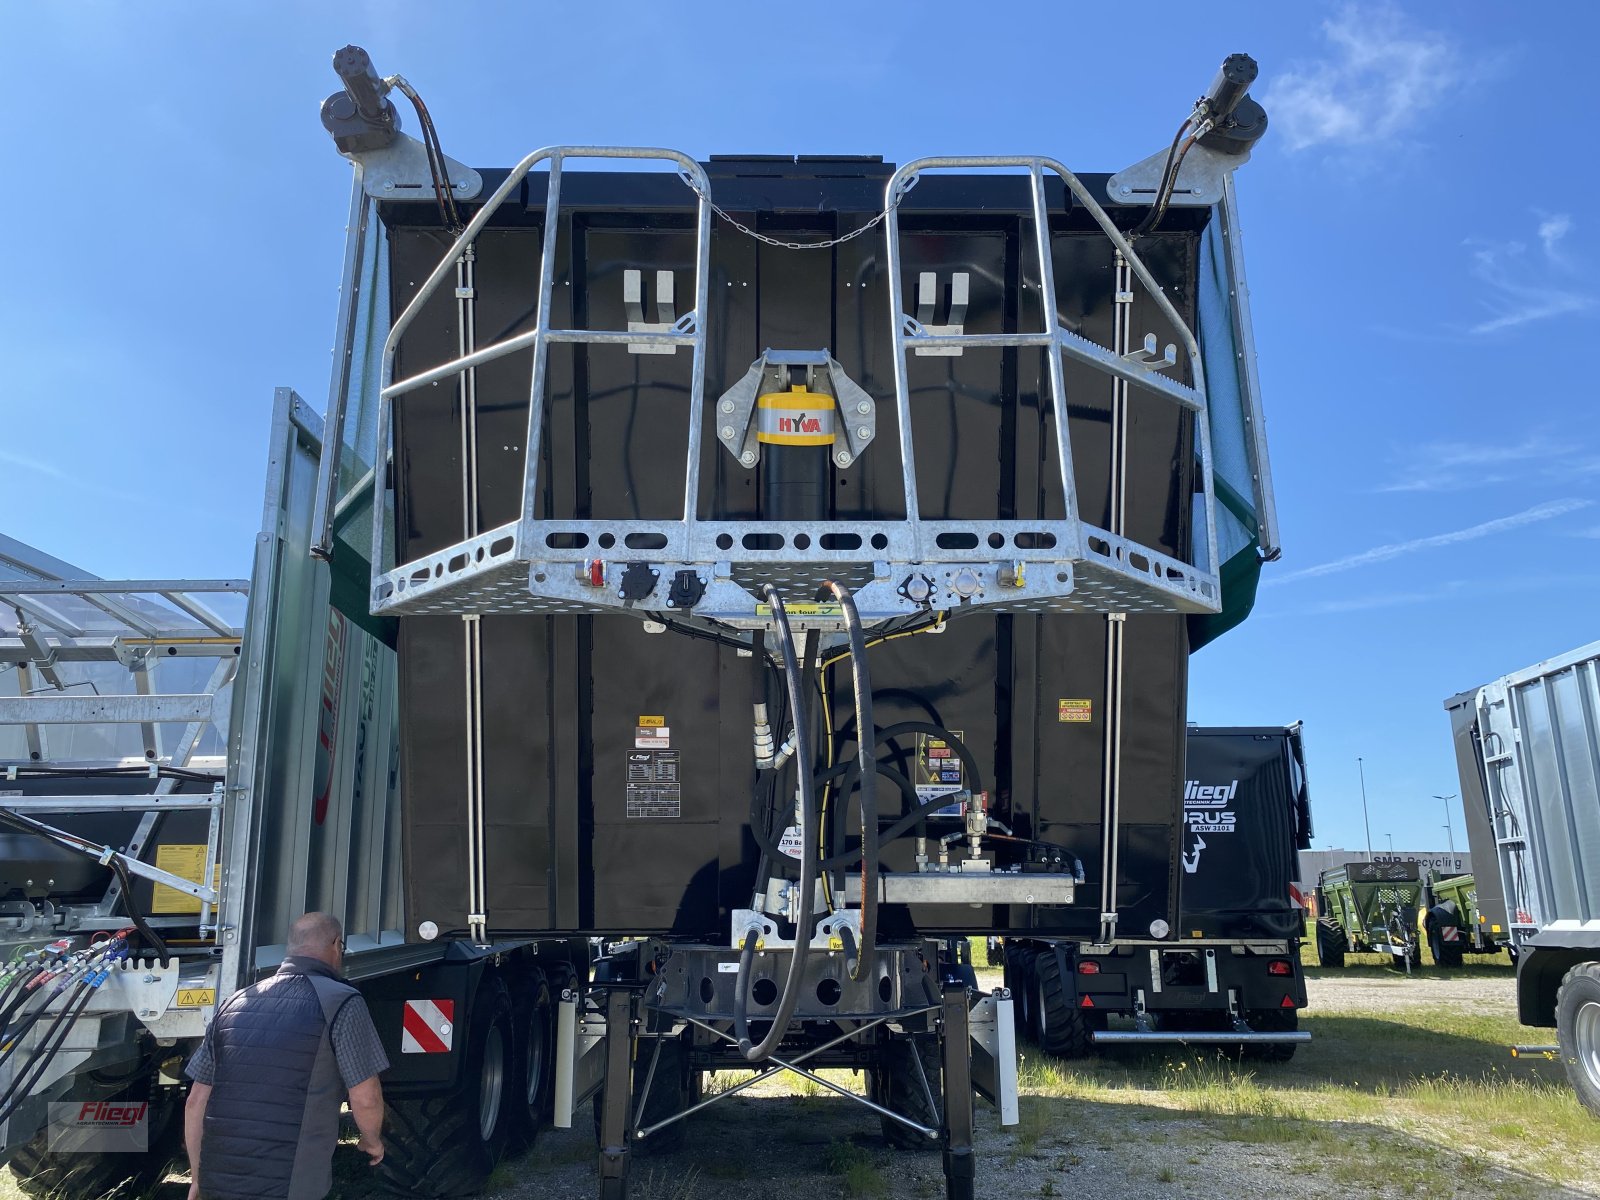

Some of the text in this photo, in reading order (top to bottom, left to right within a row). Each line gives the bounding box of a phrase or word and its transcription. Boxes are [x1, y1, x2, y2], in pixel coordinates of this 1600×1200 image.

[779, 412, 821, 432] HYVA
[1185, 780, 1238, 804] liegl
[1184, 811, 1237, 824] RUS
